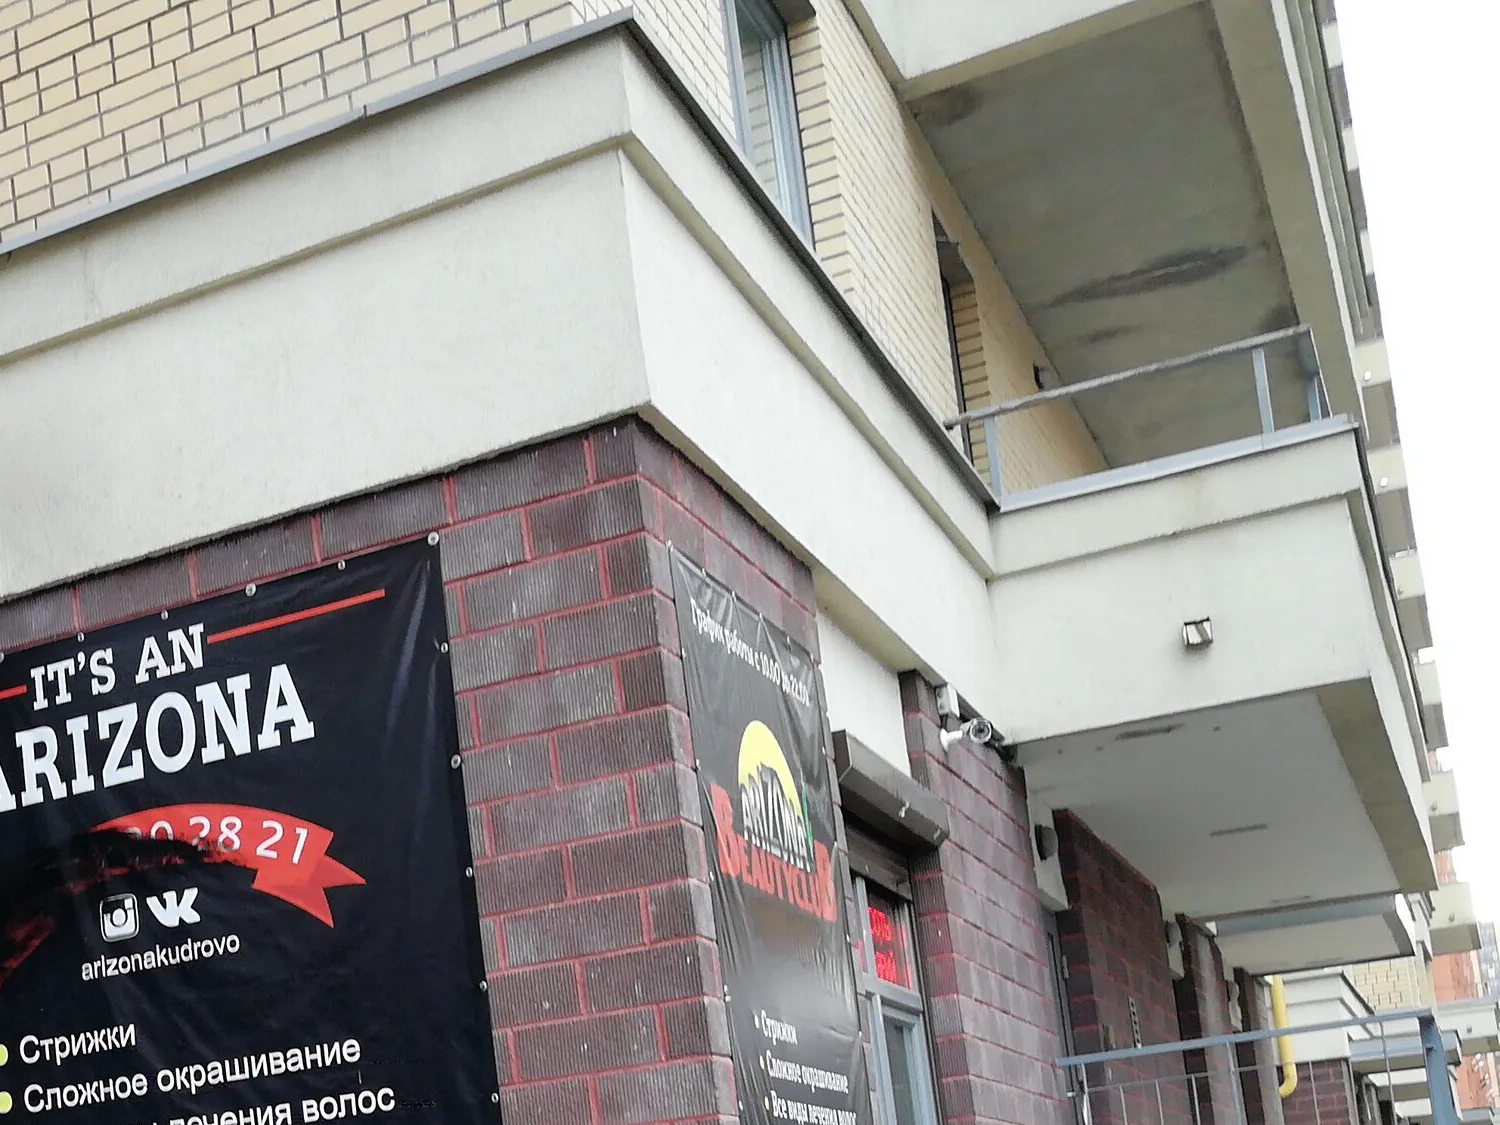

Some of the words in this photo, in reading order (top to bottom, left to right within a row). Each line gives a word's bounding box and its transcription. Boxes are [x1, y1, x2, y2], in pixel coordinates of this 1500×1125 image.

[30, 647, 117, 713] IT'S
[135, 622, 204, 685] AN
[255, 819, 309, 865] 21
[81, 933, 240, 981] arizonakudrovo
[19, 1023, 136, 1066] Стрижки
[23, 1073, 148, 1113] Сложное
[156, 1038, 361, 1092] окрашивание
[301, 1087, 396, 1124] волос
